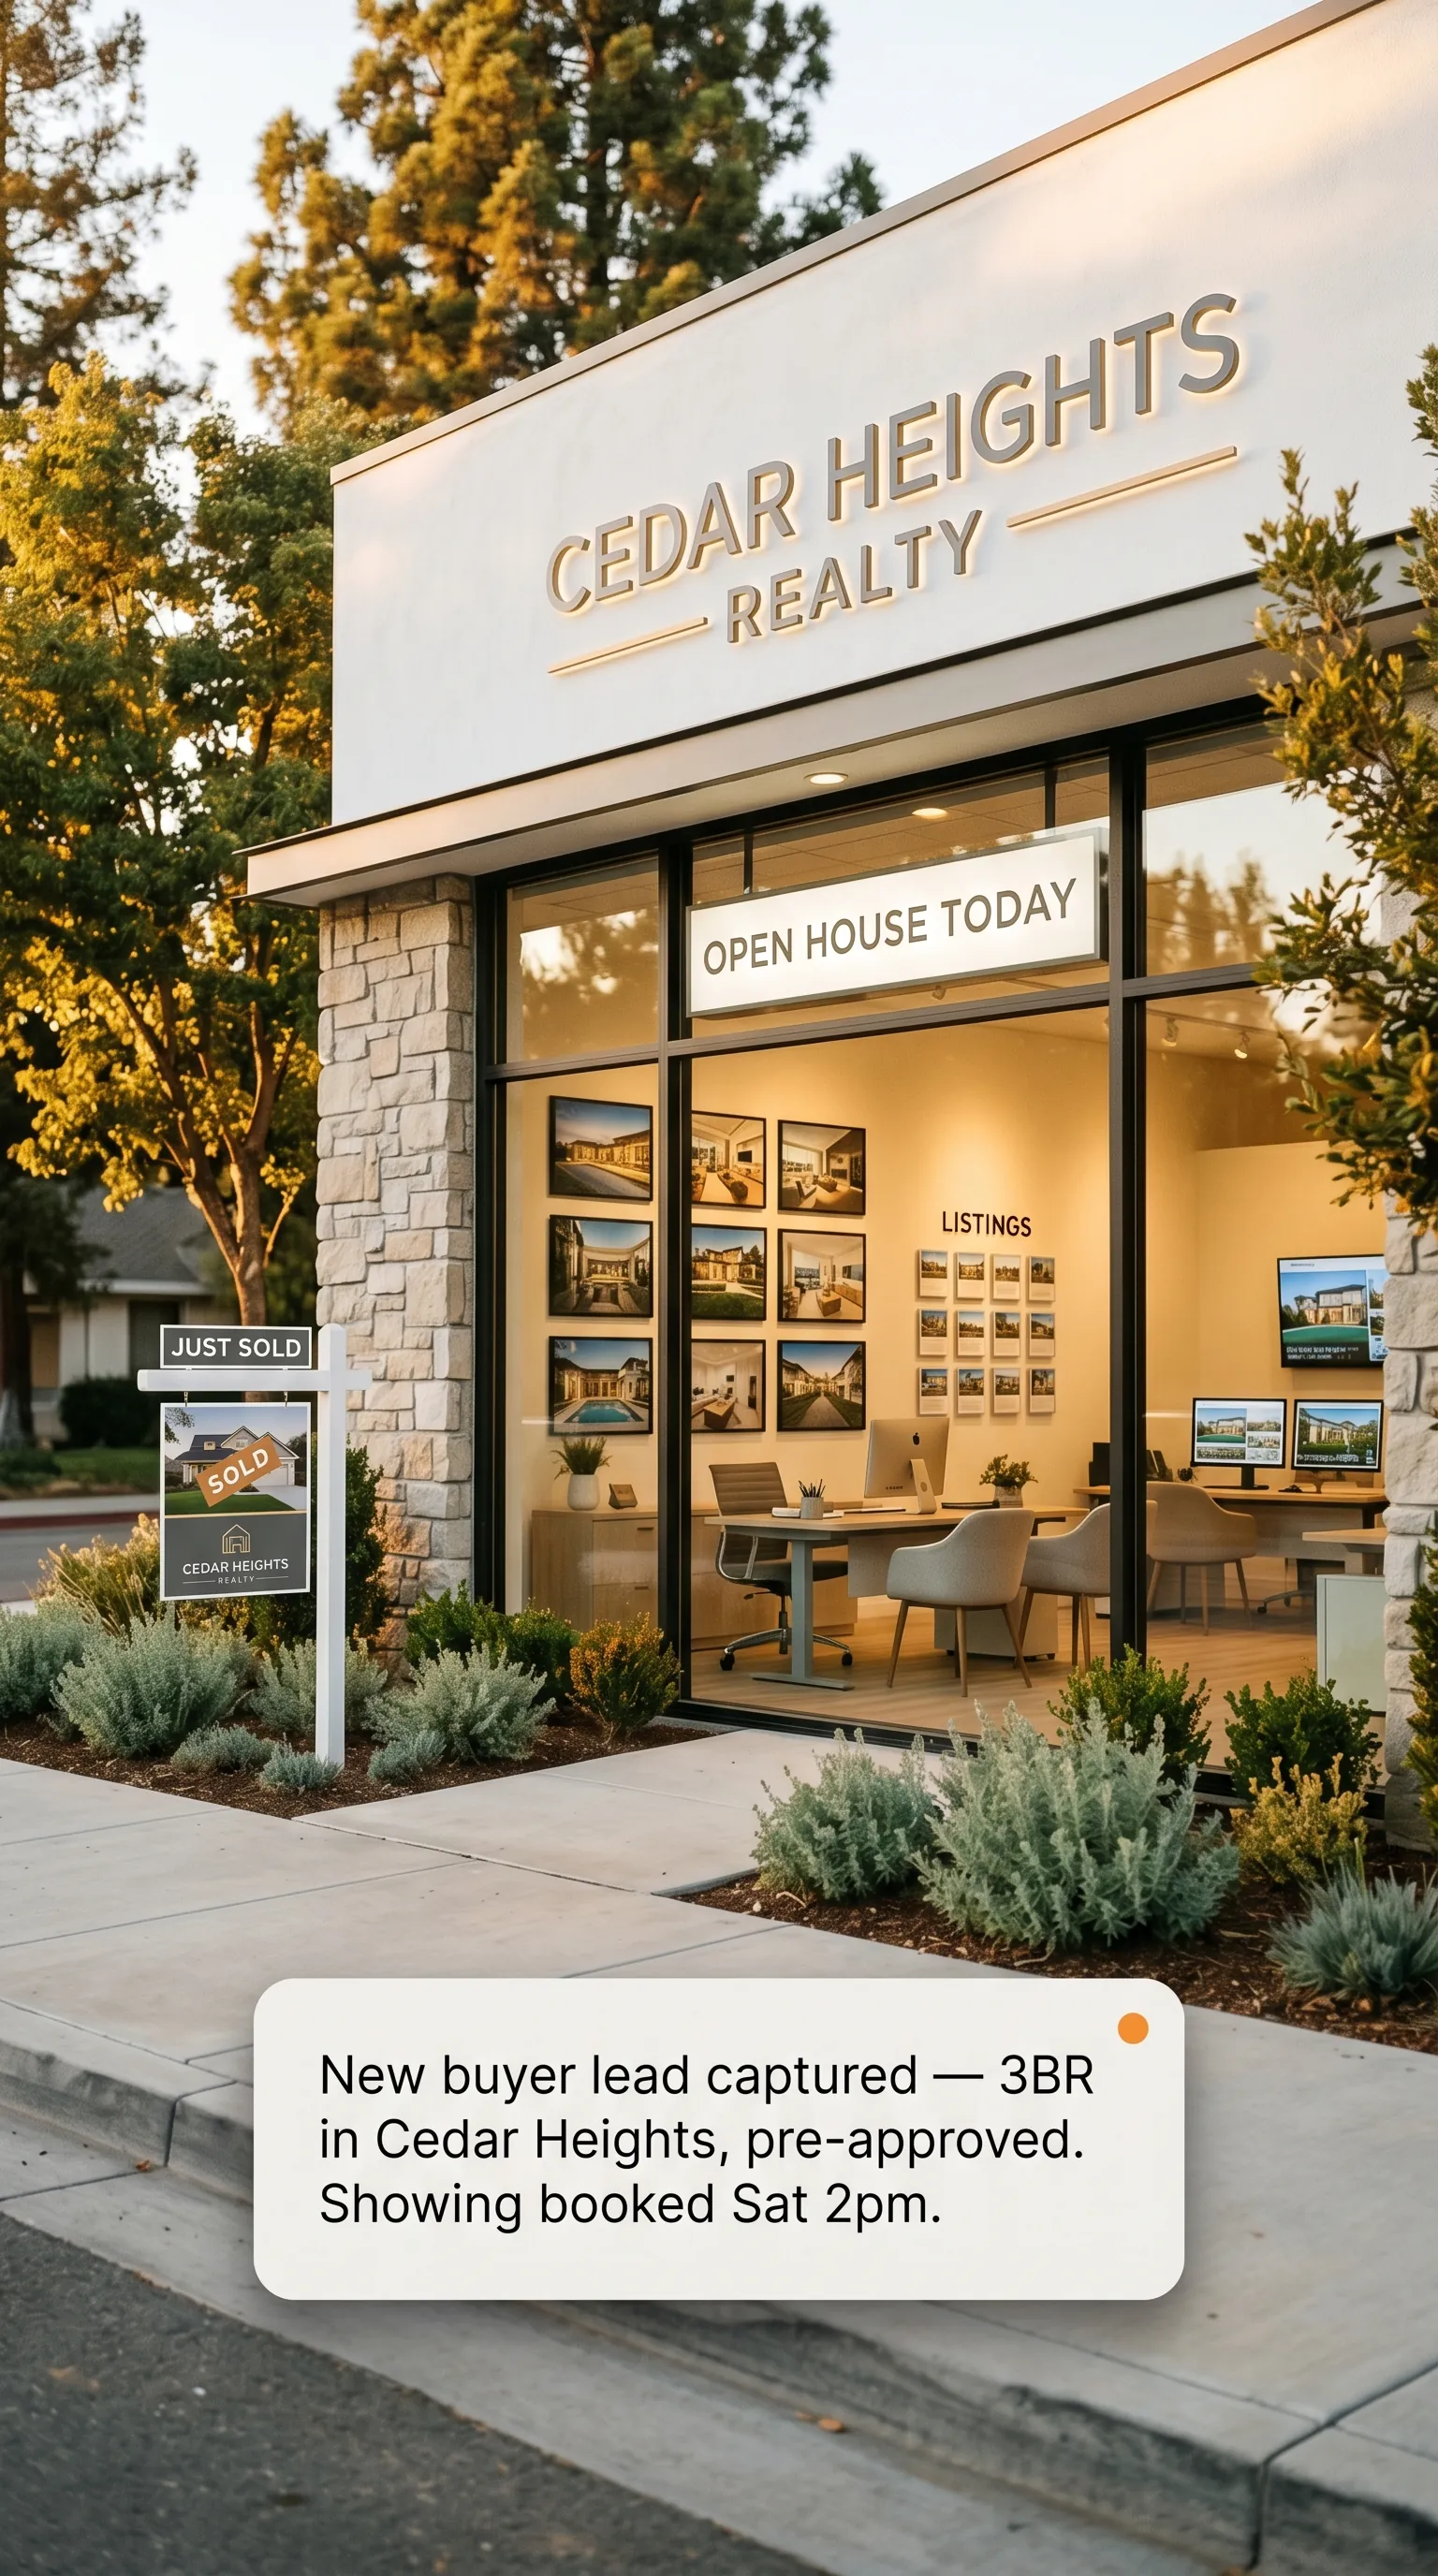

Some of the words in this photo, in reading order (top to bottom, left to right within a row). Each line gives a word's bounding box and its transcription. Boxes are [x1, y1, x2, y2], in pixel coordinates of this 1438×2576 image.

[546, 460, 798, 613] CEDAR
[827, 293, 1240, 522] HEIGHTS
[726, 509, 983, 644] REALTY
[703, 928, 793, 975] OPEN
[806, 904, 928, 960] HOUSE
[940, 877, 1078, 937] TODAY
[942, 1210, 1032, 1237] LISTINGS
[170, 1337, 232, 1357] JUST
[238, 1338, 301, 1357] SOLD
[207, 1448, 269, 1495] SOLD
[182, 1561, 229, 1575] CEDAR
[232, 1558, 289, 1573] HEIGHTS
[217, 1575, 255, 1585] REALTY
